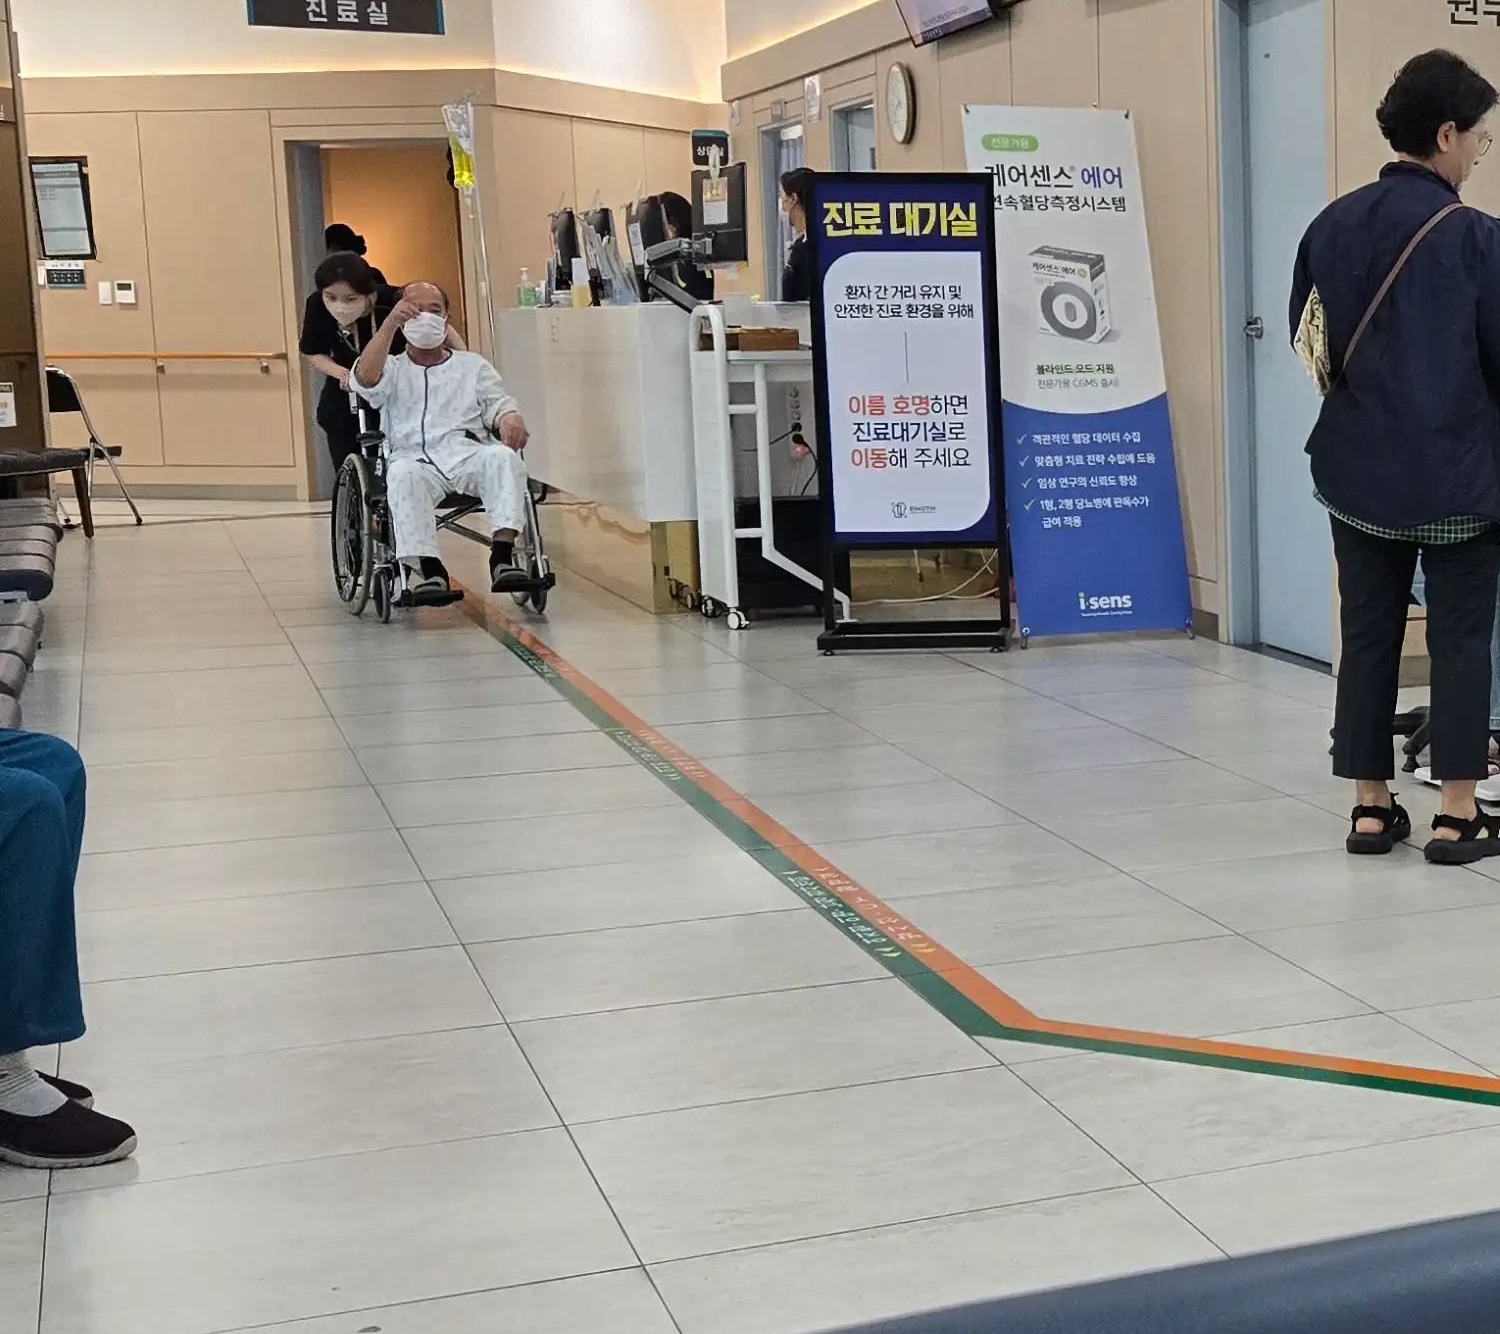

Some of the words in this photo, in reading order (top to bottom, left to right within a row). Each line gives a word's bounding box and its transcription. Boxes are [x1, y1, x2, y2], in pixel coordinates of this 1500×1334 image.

[1081, 166, 1123, 189] 에어
[823, 202, 882, 236] 진료
[889, 202, 977, 236] 대기실
[845, 285, 871, 300] 환자
[876, 286, 888, 300] 간
[892, 285, 916, 300] 거리
[920, 285, 945, 300] 유지
[949, 285, 962, 300] 및
[834, 304, 873, 318] 안전한
[876, 304, 902, 318] 진료
[906, 304, 944, 318] 환경을
[948, 304, 974, 318] 위해
[1036, 364, 1073, 375] 블라인드
[1096, 363, 1114, 374] 지원
[1073, 379, 1098, 389] CGMS
[849, 395, 886, 415] 이름
[892, 394, 968, 415] 호명하면
[852, 421, 966, 442] 진료대기실로
[1032, 434, 1070, 445] 객관적인
[1072, 433, 1090, 444] 혈당
[1093, 432, 1120, 443] 데이터
[1123, 432, 1141, 443] 수집
[851, 448, 907, 468] 이동해
[914, 448, 971, 468] 주세요
[1035, 456, 1063, 467] 맞춤형
[1065, 455, 1084, 466] 치료
[1137, 452, 1156, 464] 도움
[1037, 478, 1056, 489] 임상
[1059, 477, 1087, 488] 연구의
[1089, 476, 1117, 487] 신뢰도
[1119, 475, 1137, 486] 향상
[1075, 497, 1112, 510] 당뇨병에
[1042, 517, 1061, 529] 급여
[1064, 516, 1082, 528] 적용
